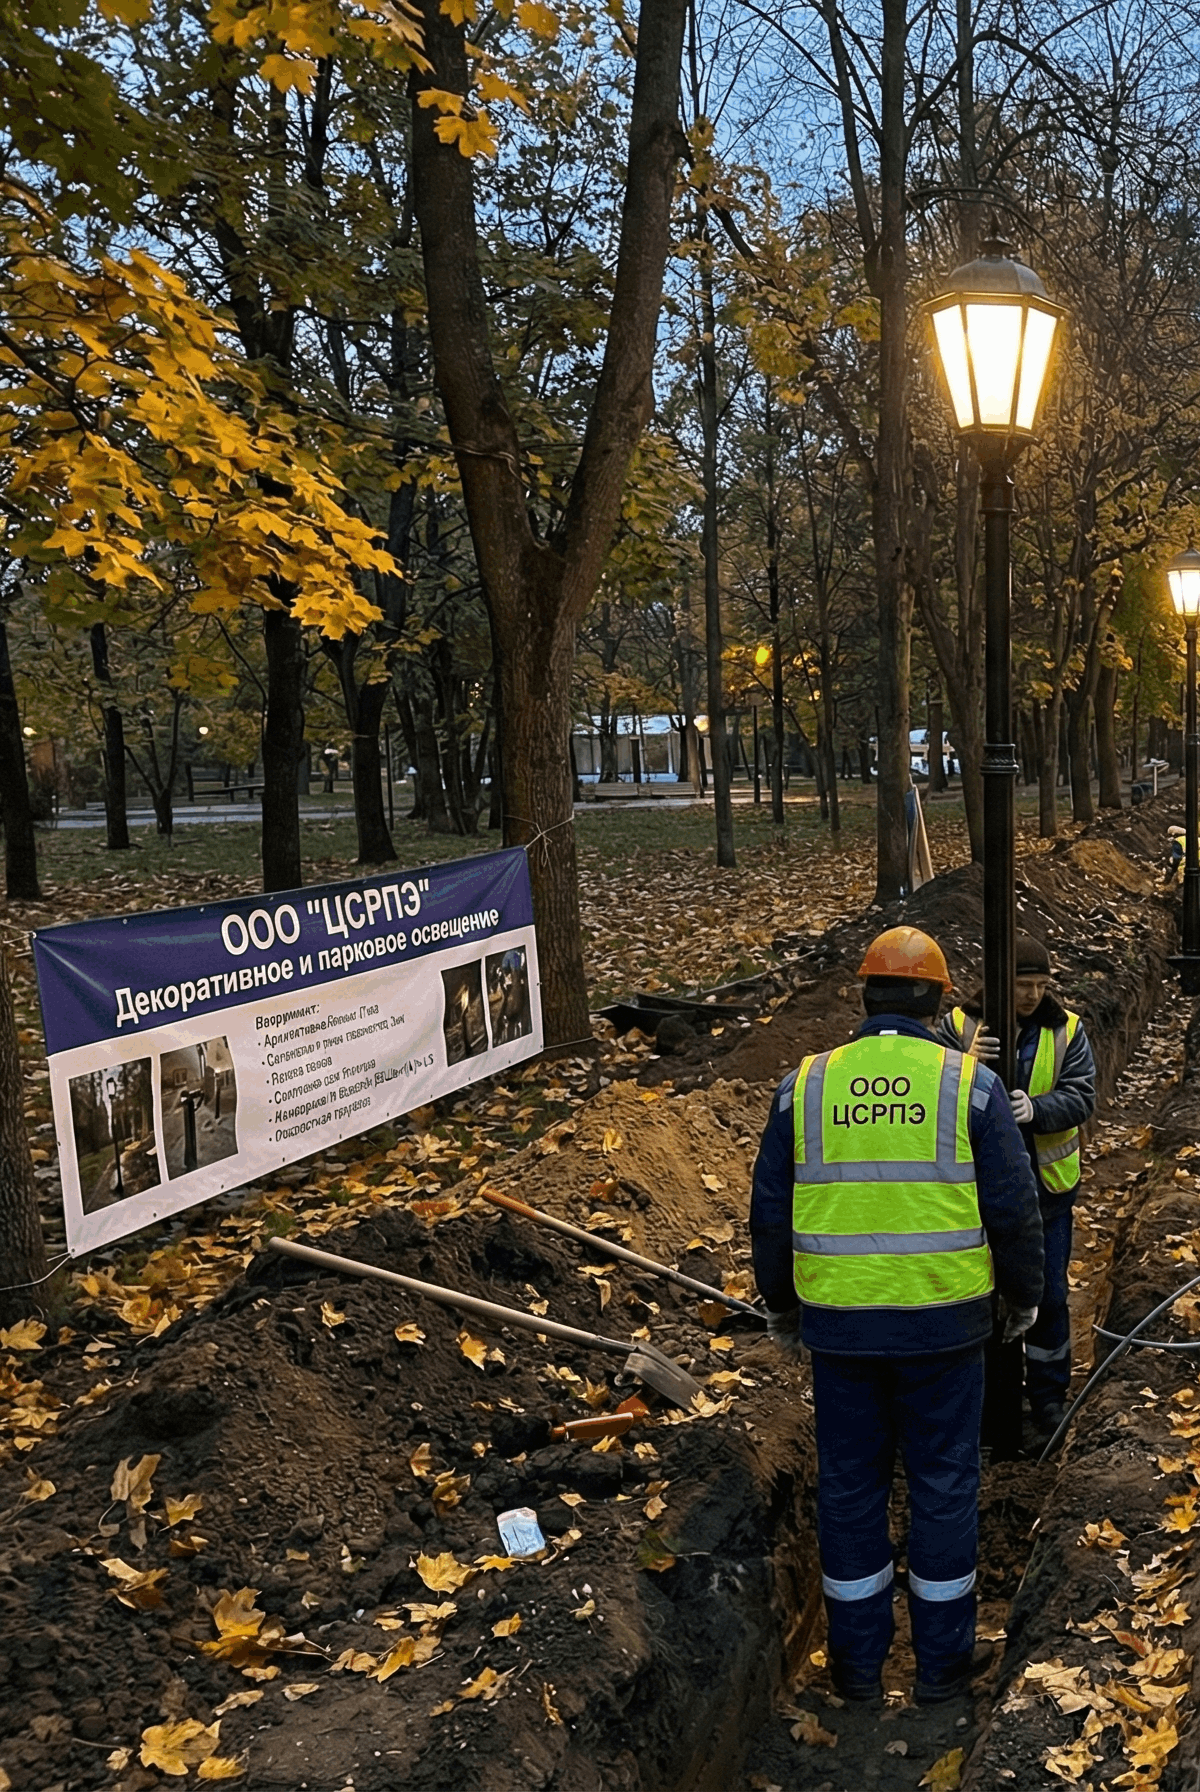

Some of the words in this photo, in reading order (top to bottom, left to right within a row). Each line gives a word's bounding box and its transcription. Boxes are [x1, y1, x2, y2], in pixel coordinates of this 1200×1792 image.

[221, 904, 300, 956] ООО
[307, 879, 430, 939] "ЦСРПЭ"
[115, 958, 294, 1028] Декоративное
[299, 954, 313, 976] и
[318, 931, 407, 972] парковое
[411, 908, 499, 947] освещение
[849, 1076, 911, 1097] ООО
[832, 1103, 926, 1129] ЦСРПЭ
